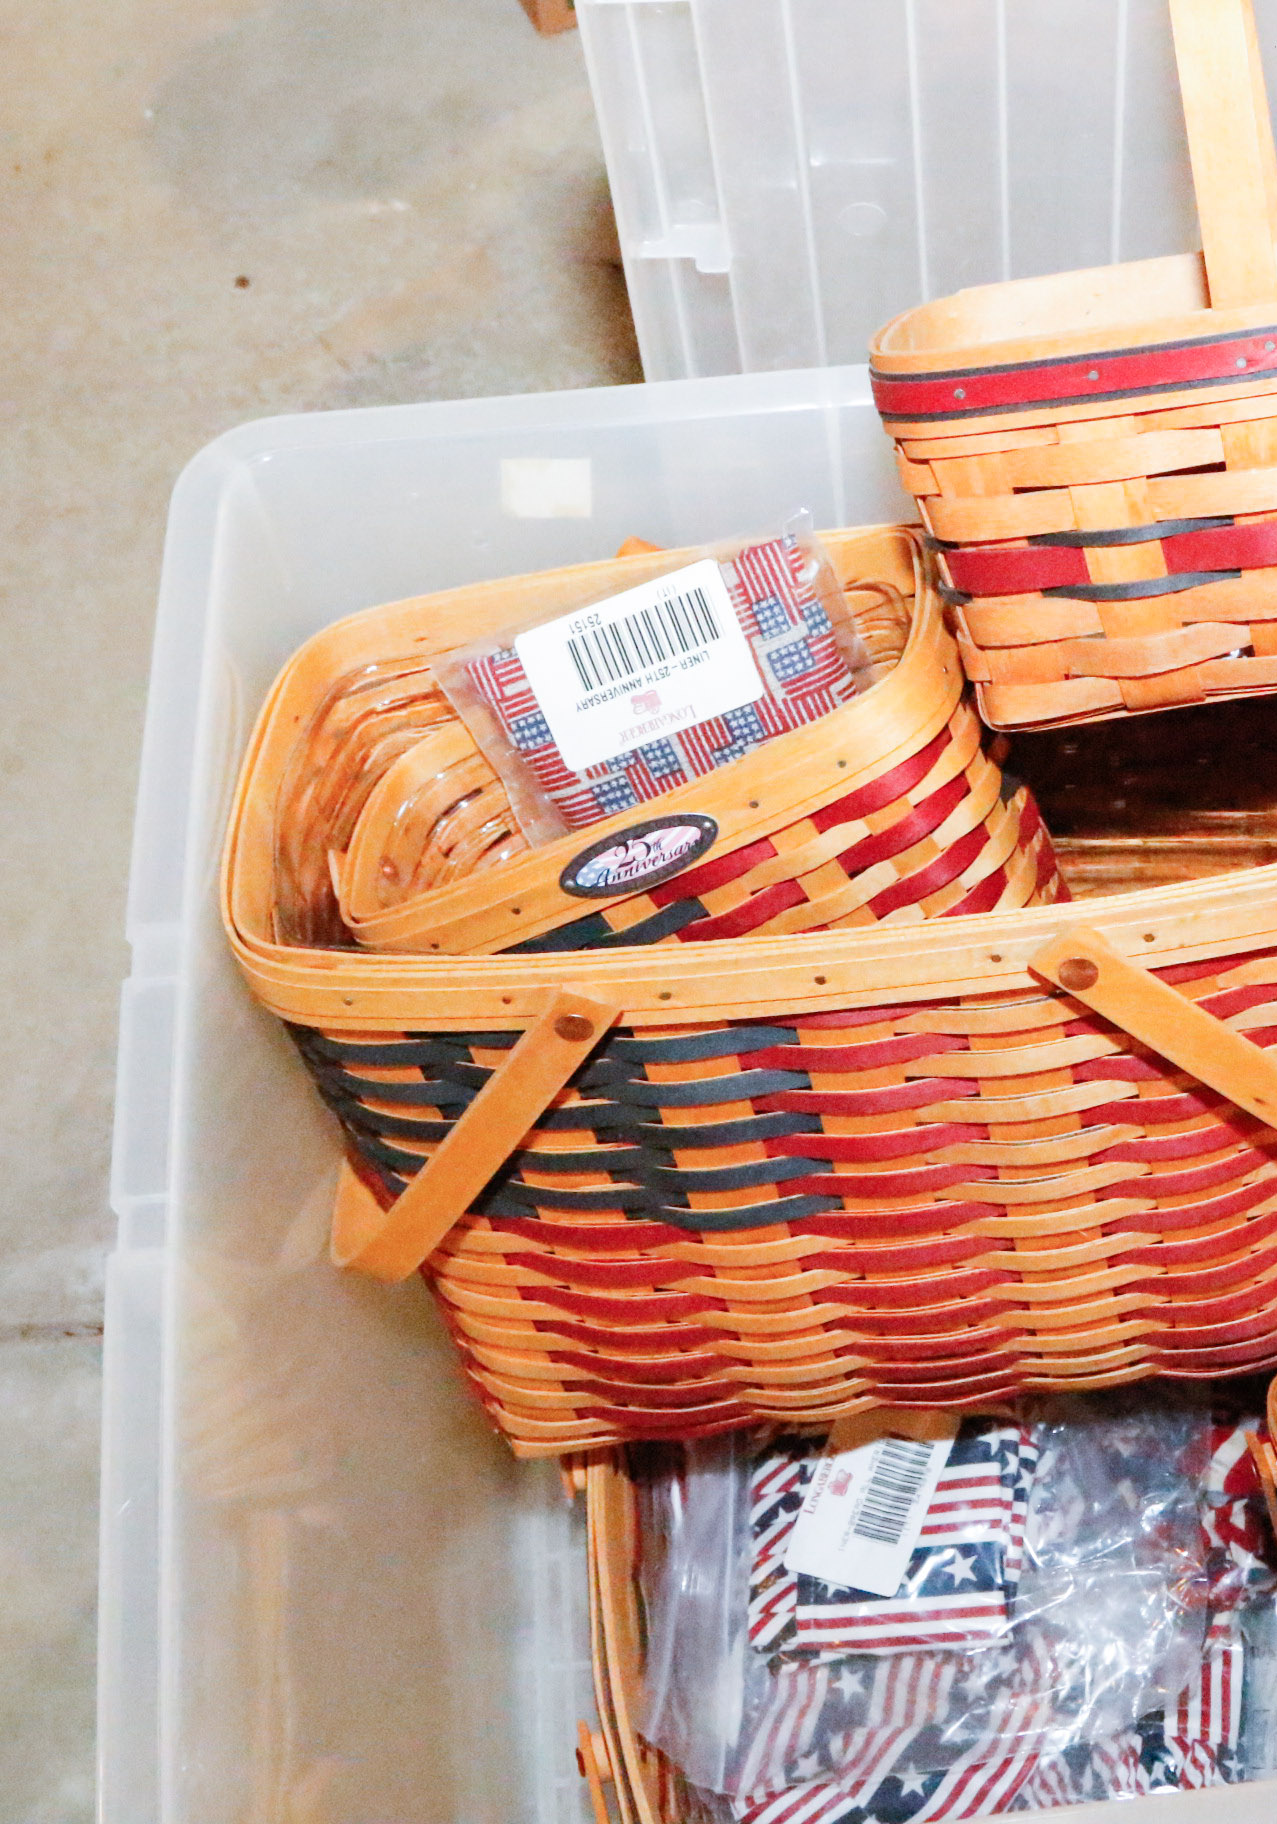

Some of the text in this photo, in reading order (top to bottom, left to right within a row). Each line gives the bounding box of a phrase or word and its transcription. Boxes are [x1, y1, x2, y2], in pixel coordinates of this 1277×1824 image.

[568, 613, 602, 635] 25151
[678, 650, 711, 671] LINER
[644, 665, 671, 685] 25TH
[575, 677, 643, 713] ANNIVERSARY
[614, 837, 663, 871] 25th
